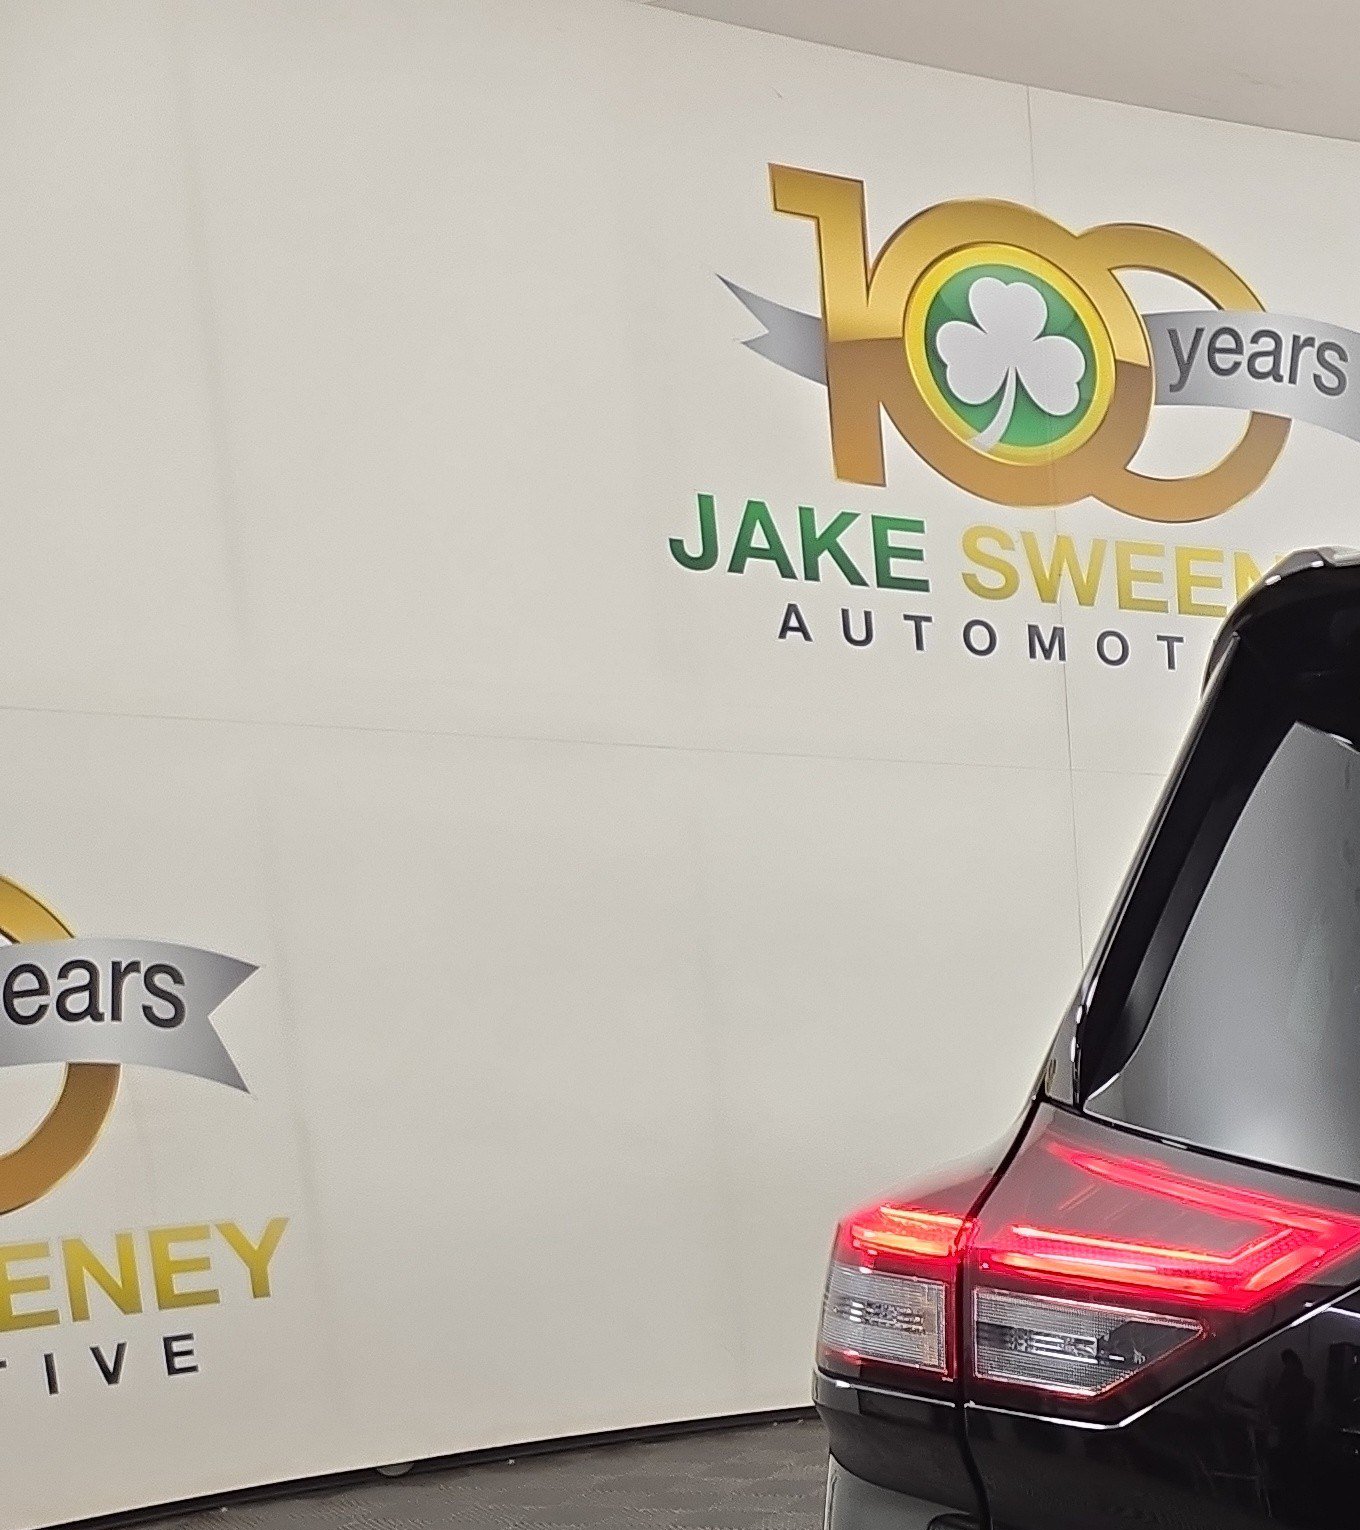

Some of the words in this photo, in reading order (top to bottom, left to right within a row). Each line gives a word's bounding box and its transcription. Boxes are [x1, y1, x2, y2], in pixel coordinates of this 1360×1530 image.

[1167, 323, 1351, 398] years
[668, 493, 931, 593] JAKE
[1, 957, 187, 1030] ears
[0, 1333, 199, 1395] IVE
